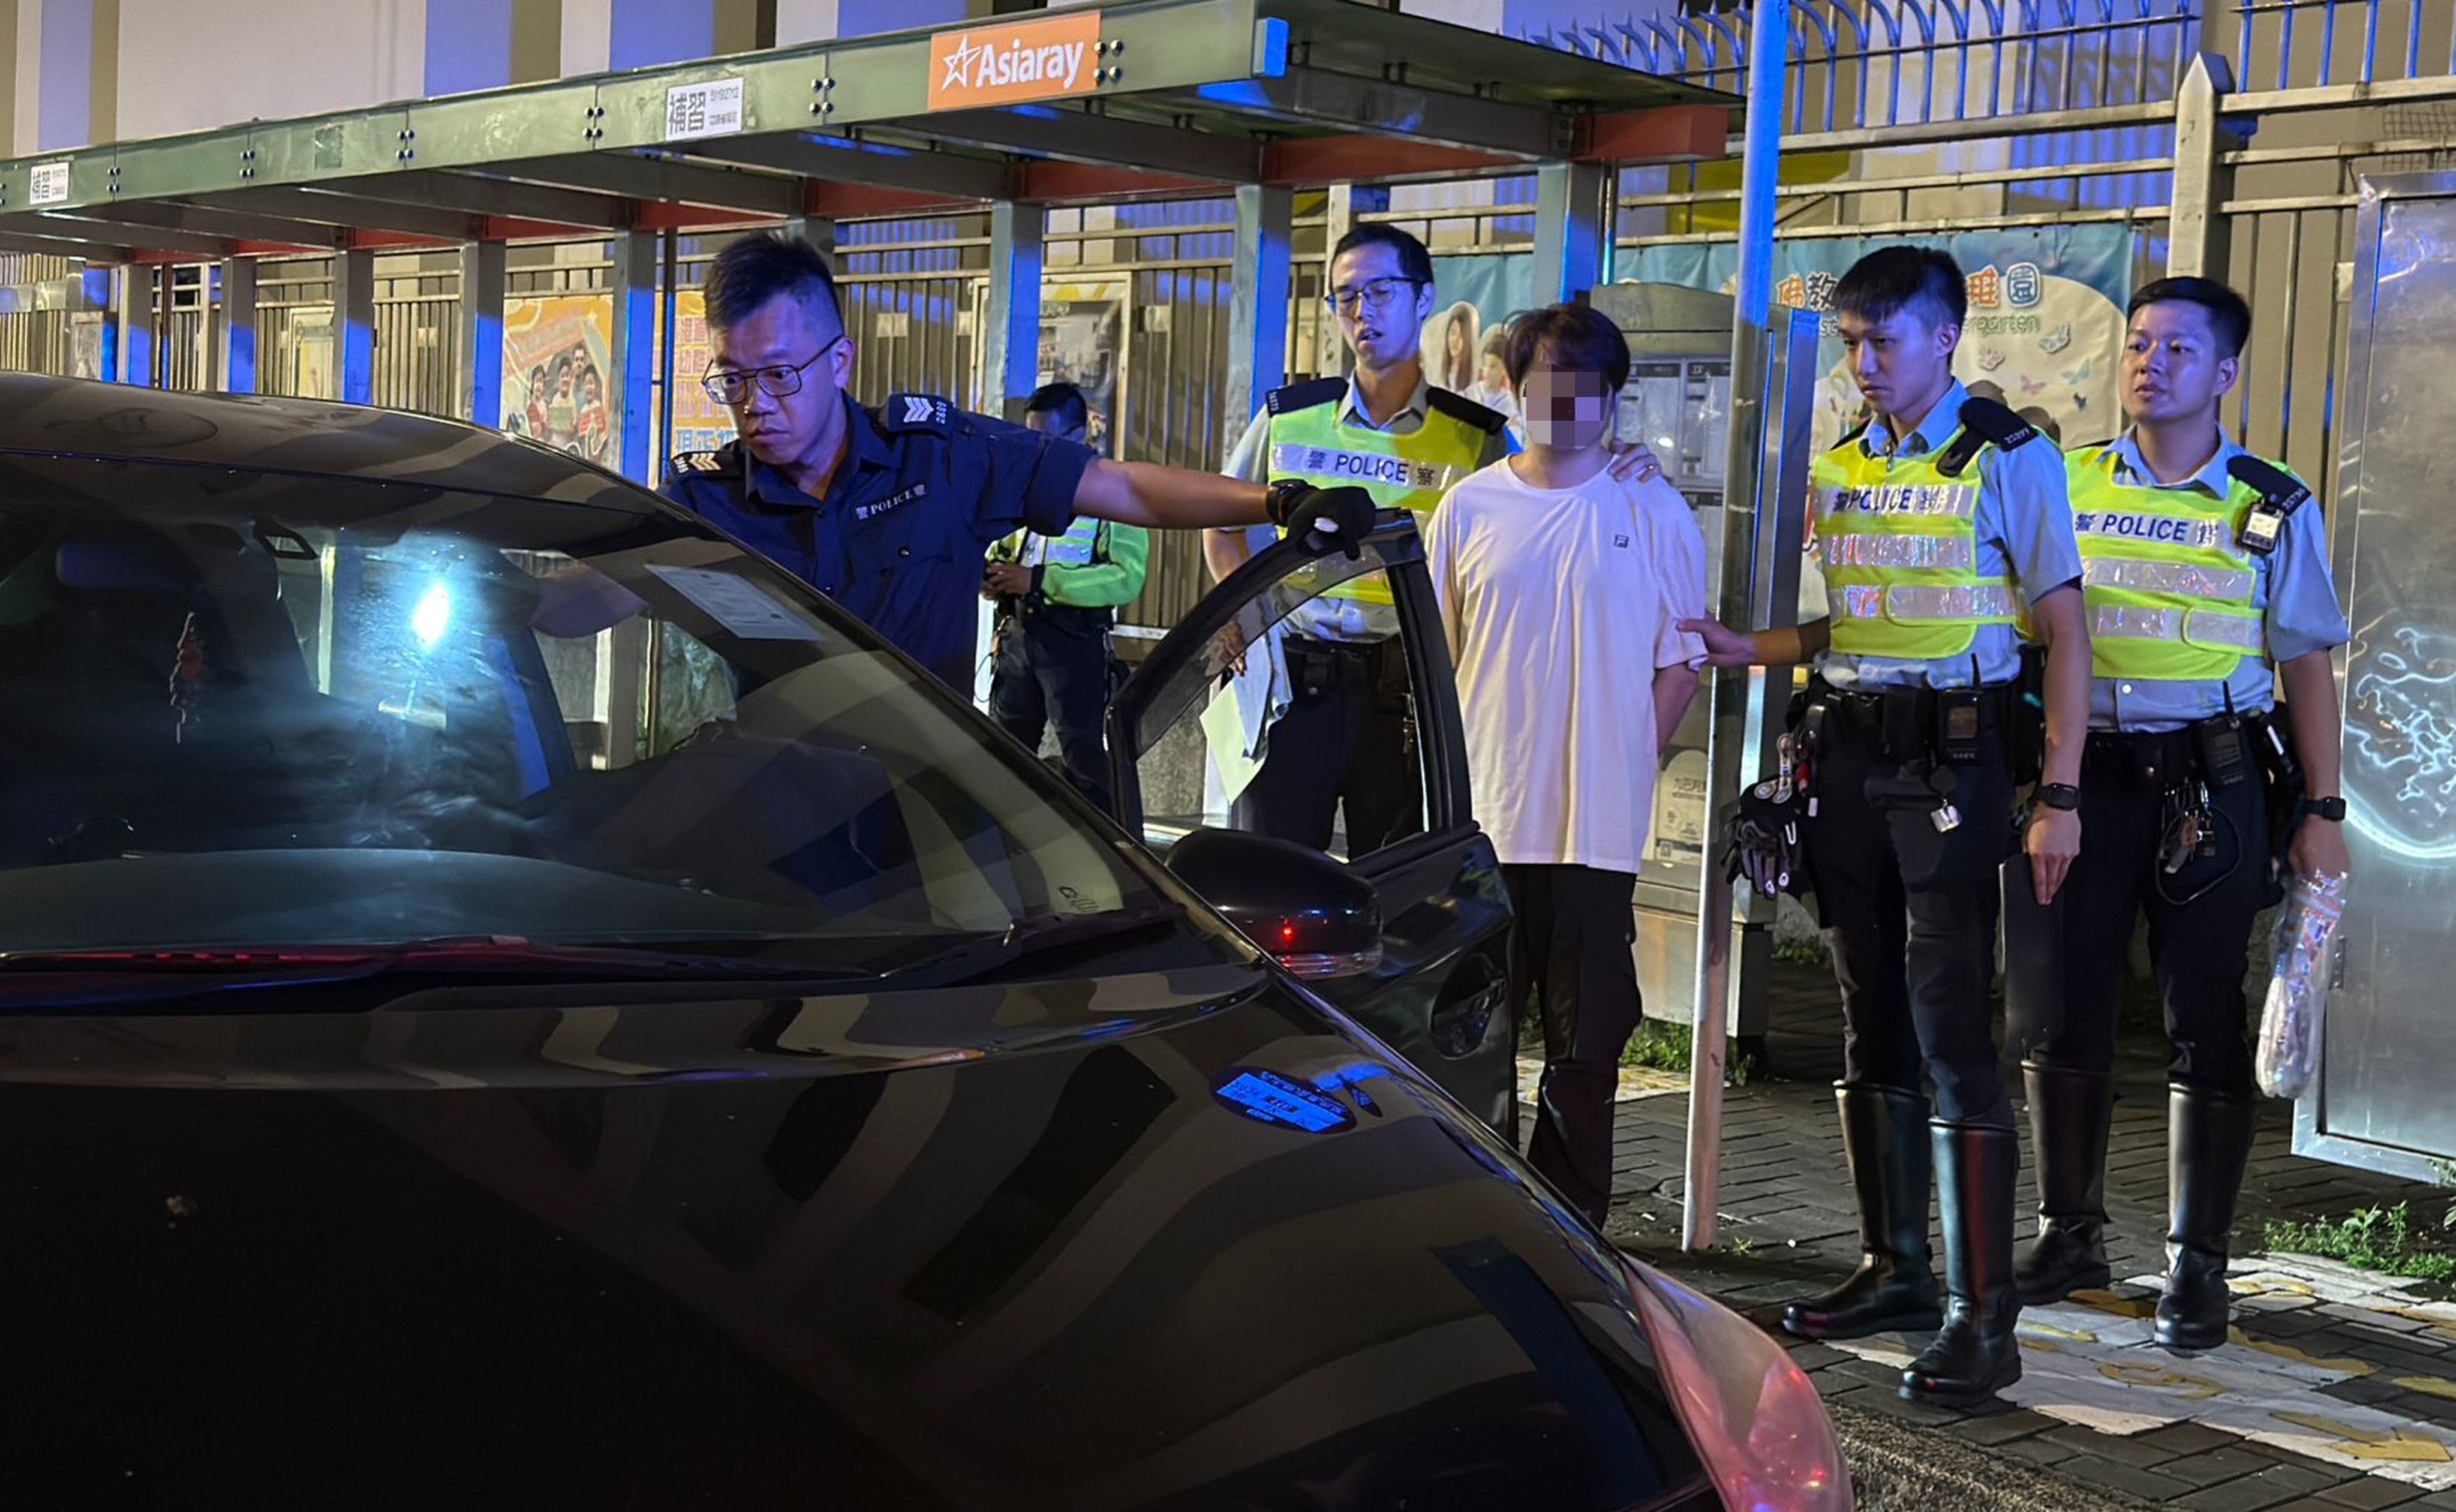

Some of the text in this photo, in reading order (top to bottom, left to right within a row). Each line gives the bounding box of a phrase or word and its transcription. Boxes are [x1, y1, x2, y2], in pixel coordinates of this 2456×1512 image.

[975, 38, 1084, 89] Asiaray
[1335, 456, 1409, 482] POLICE
[870, 489, 915, 515] POLICE
[2102, 514, 2189, 542] POLICE
